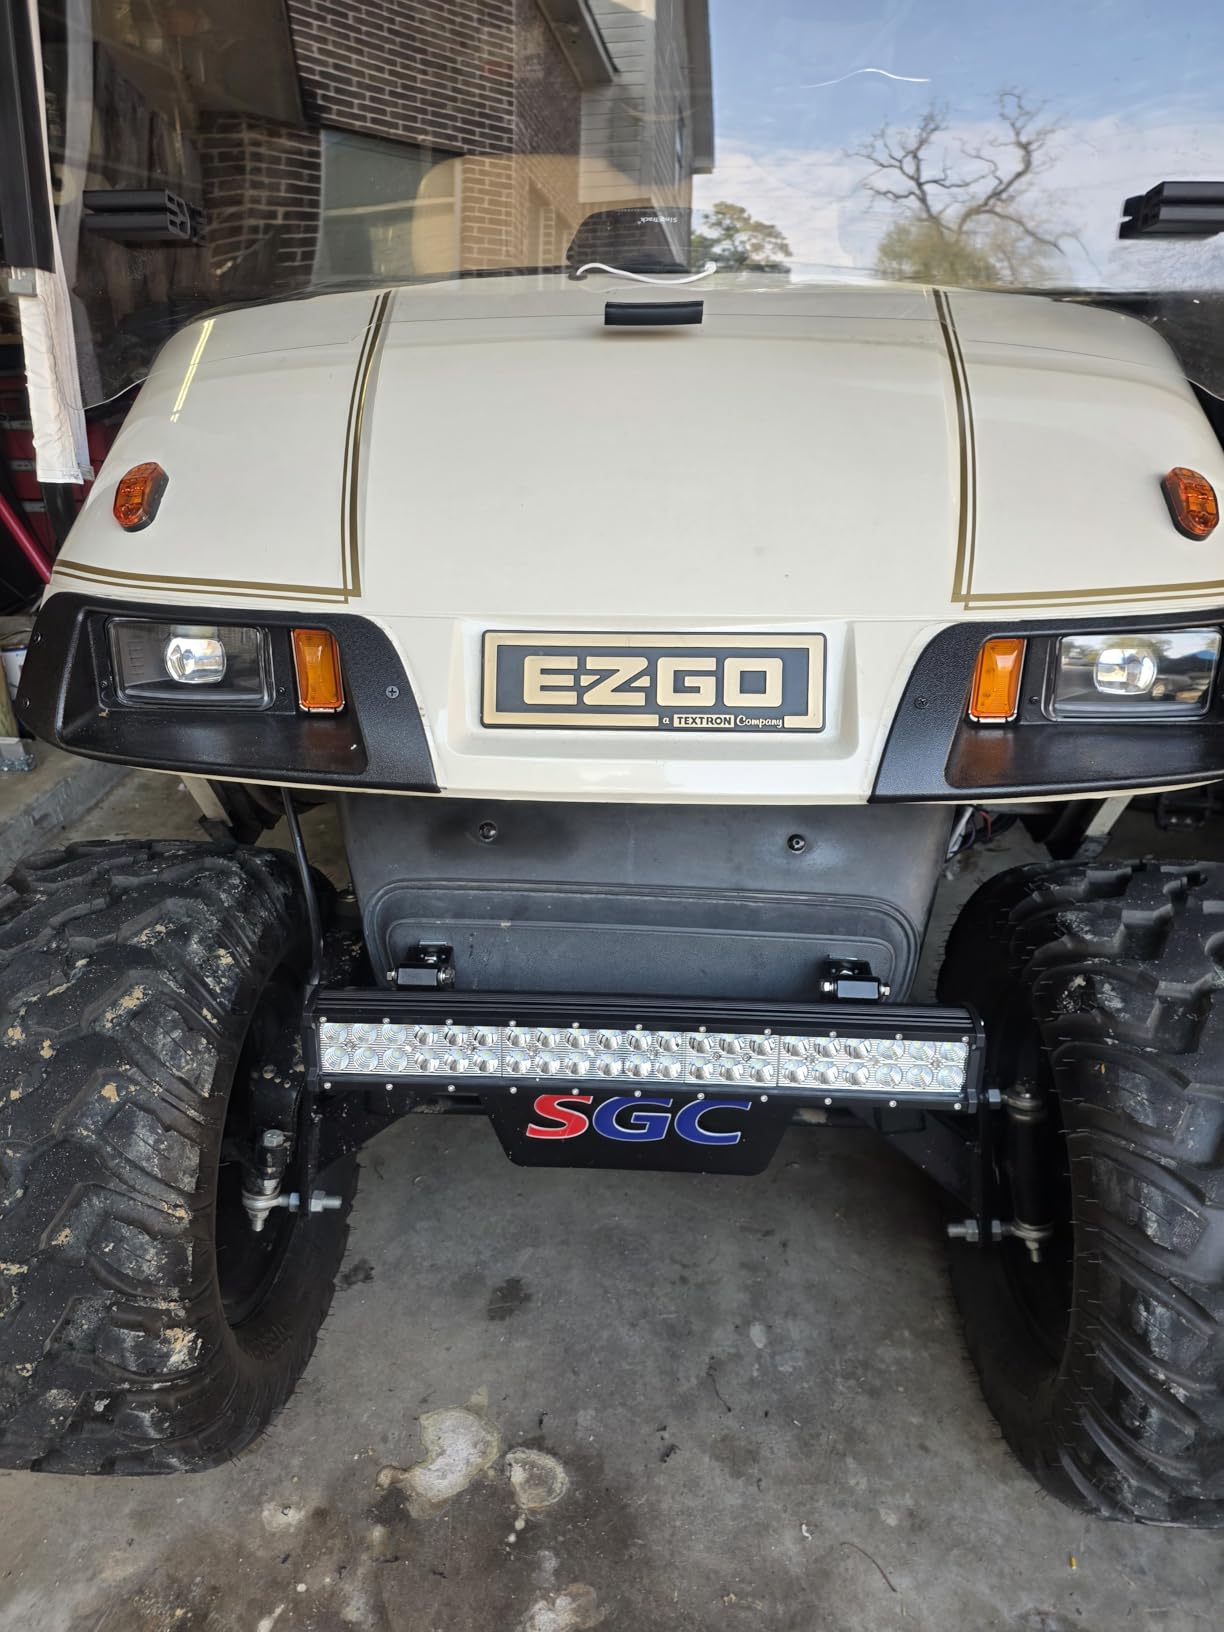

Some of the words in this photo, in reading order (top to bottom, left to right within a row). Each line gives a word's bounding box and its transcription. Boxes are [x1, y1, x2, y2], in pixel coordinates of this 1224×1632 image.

[662, 717, 670, 725] a
[676, 716, 732, 727] TEXTRON
[736, 715, 783, 728] Company
[526, 1094, 752, 1146] SGC
